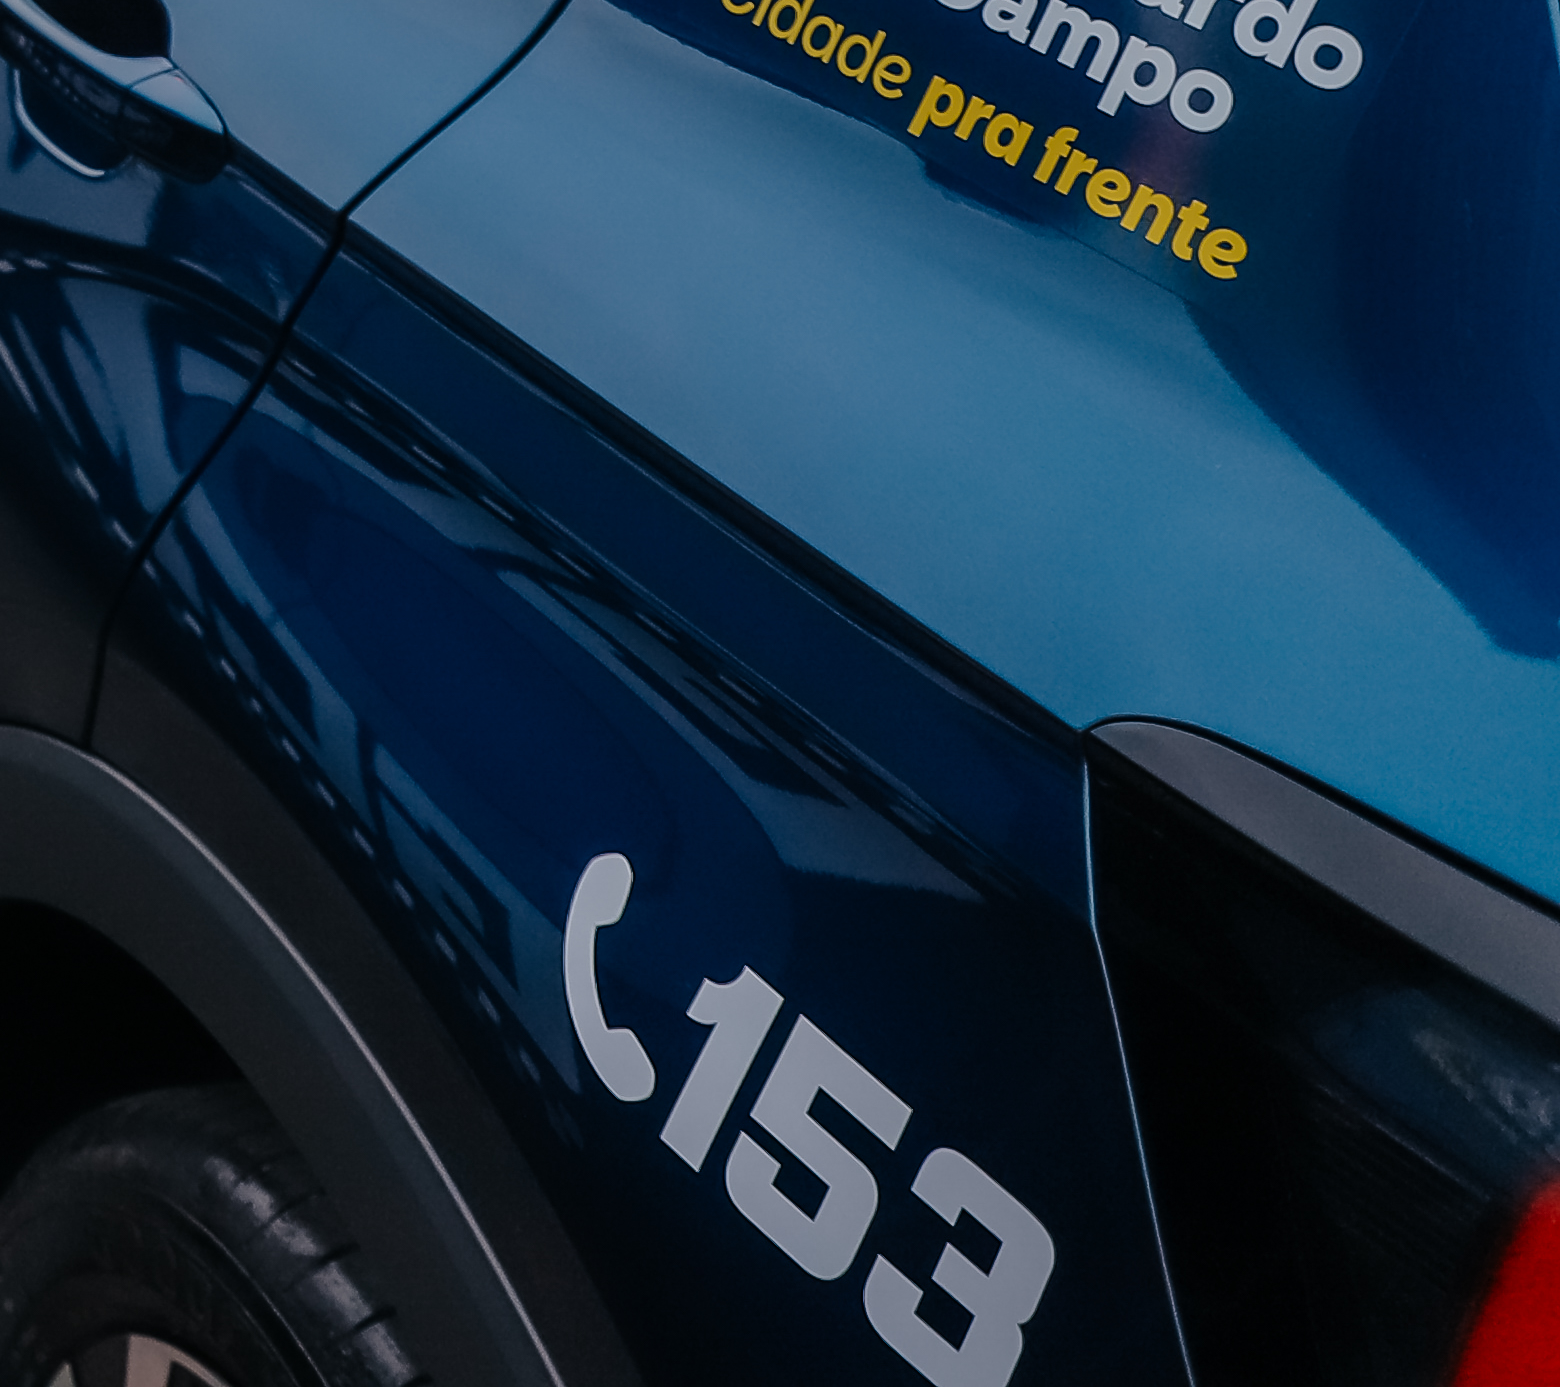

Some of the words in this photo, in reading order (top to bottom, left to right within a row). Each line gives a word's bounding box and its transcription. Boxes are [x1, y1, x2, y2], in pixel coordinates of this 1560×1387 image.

[907, 75, 1033, 166] pra
[1034, 128, 1248, 281] frente
[659, 965, 1054, 1387] 153
